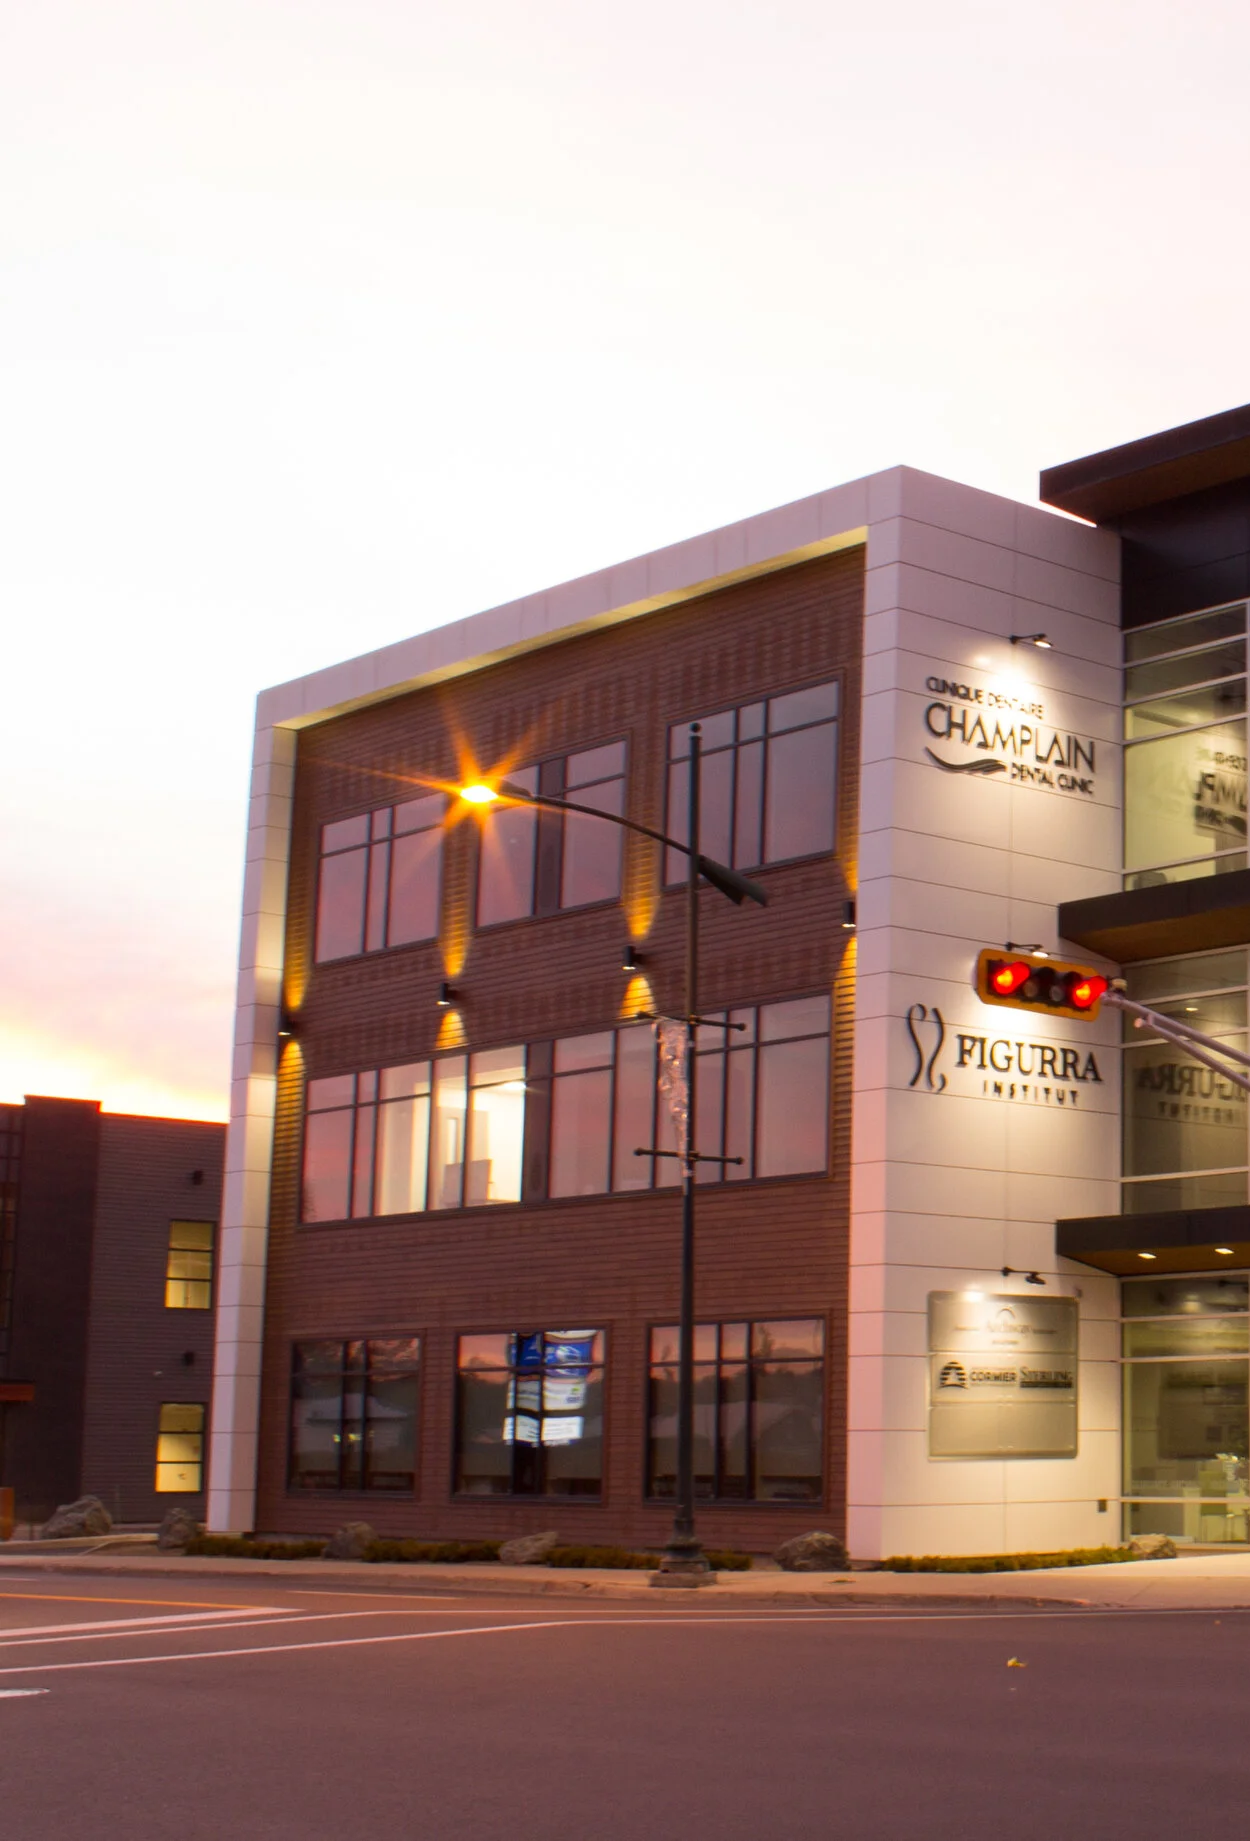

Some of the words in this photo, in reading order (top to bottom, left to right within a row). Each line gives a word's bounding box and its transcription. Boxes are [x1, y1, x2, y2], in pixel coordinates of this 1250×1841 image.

[926, 676, 984, 704] CLINIQUE
[925, 702, 1095, 773] CHAMPLAIN
[1011, 762, 1054, 789] DENTAL
[1057, 773, 1094, 795] CLINIC
[956, 1034, 1103, 1082] FIGURRA
[983, 1079, 1079, 1106] INSTITUT
[970, 1371, 1017, 1382] CORMIER
